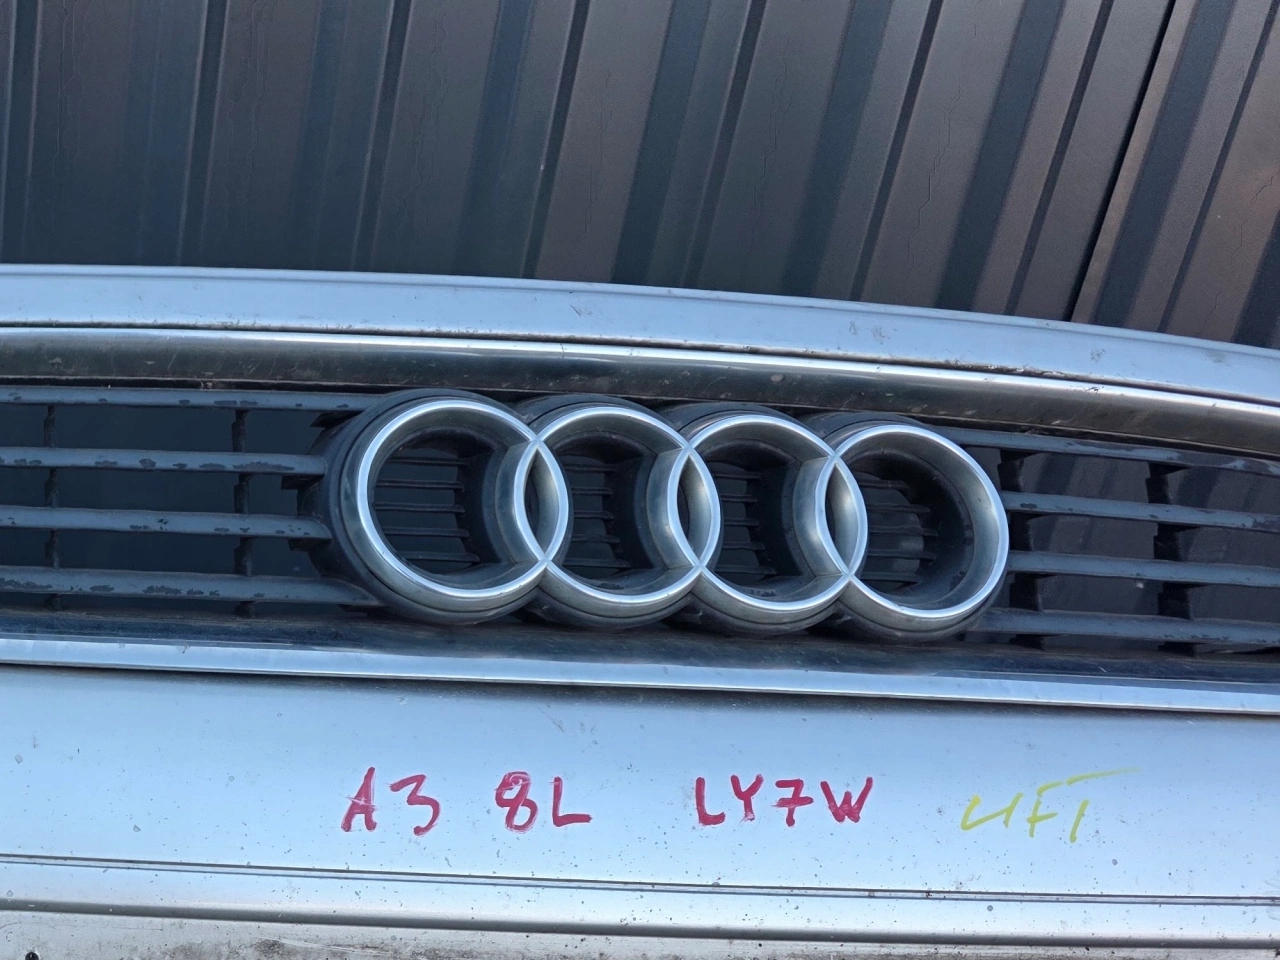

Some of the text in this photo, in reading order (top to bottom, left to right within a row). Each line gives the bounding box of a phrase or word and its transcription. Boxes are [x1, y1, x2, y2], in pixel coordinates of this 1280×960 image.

[341, 766, 442, 836] A3
[493, 770, 593, 831] 8L
[694, 775, 875, 827] LY7W
